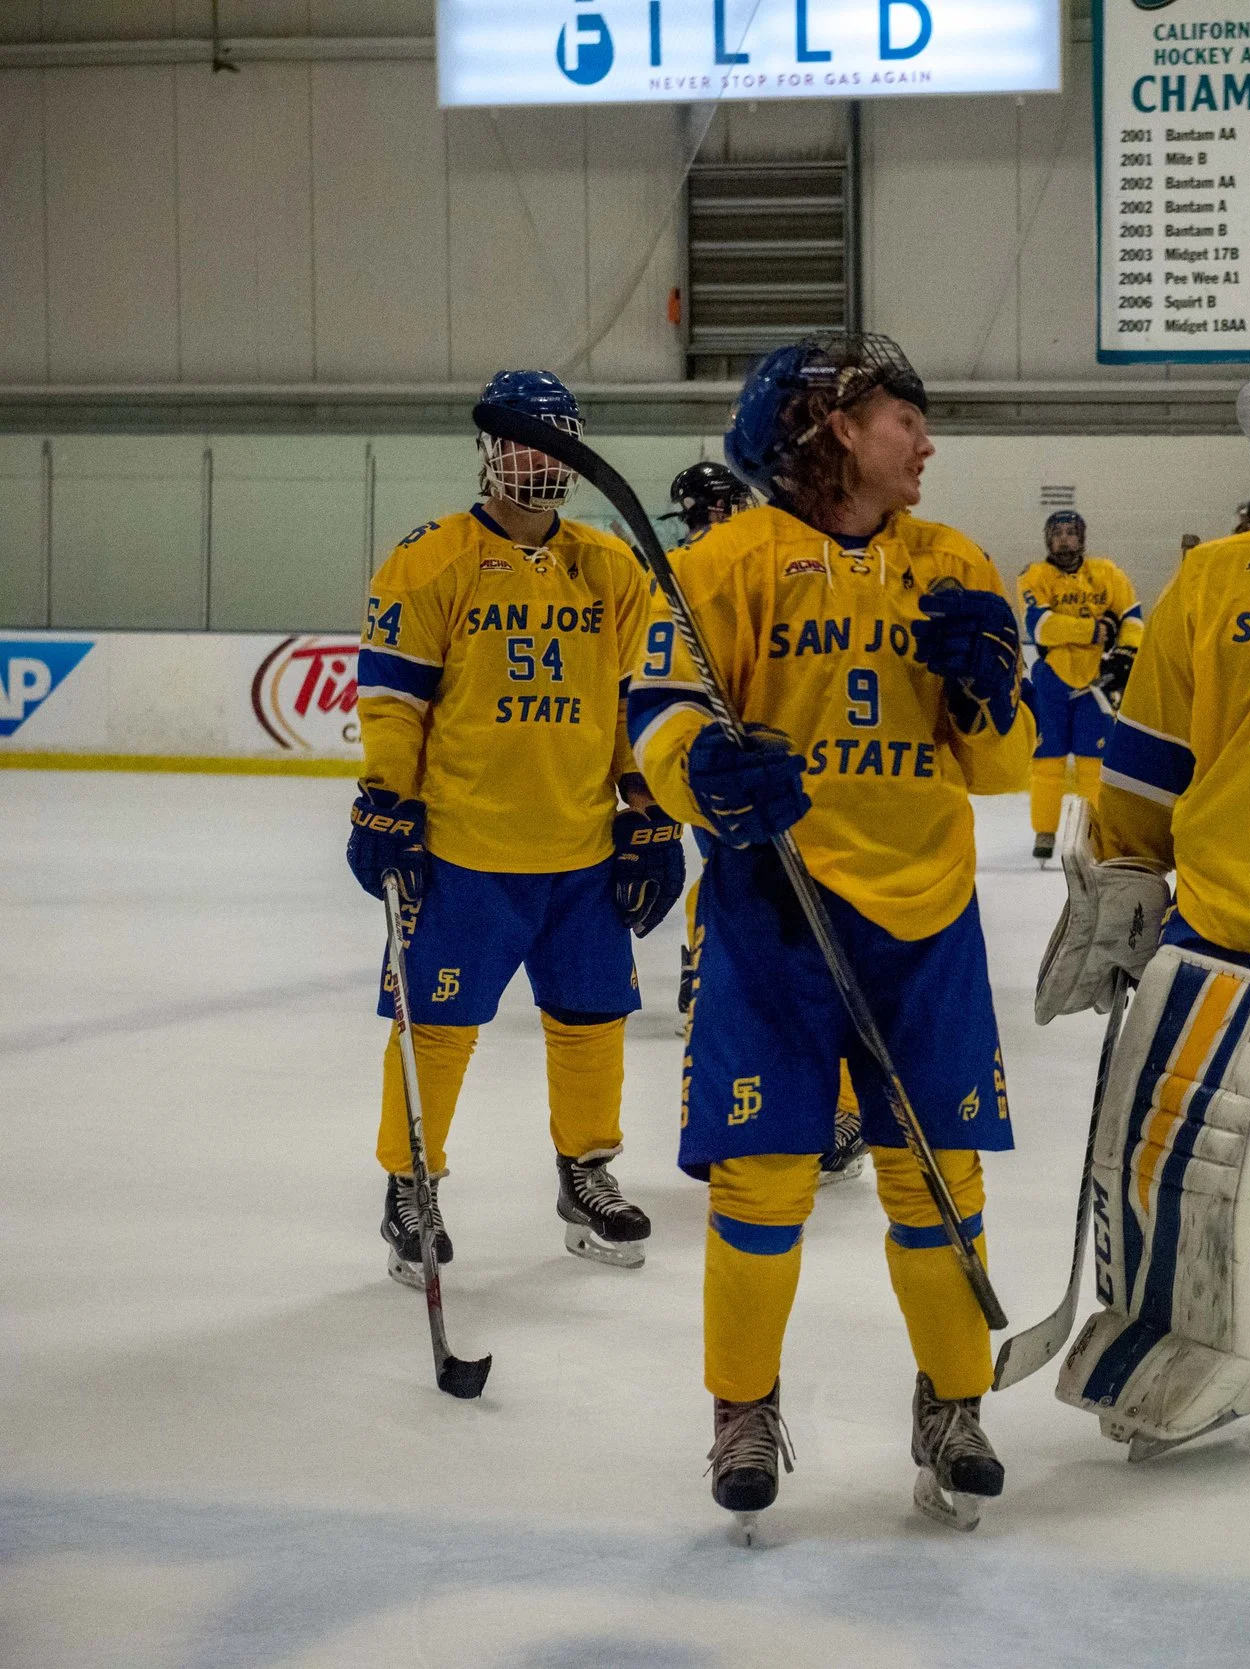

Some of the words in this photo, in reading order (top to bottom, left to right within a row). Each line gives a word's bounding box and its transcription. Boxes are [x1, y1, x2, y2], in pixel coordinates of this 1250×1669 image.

[1154, 47, 1233, 65] HOCKEY
[649, 76, 711, 90] NEVER
[721, 75, 767, 89] STOP
[777, 73, 814, 87] FOR
[824, 72, 861, 86] GAS
[871, 71, 932, 84] AGAIN
[1120, 129, 1152, 143] 2001
[1165, 128, 1215, 142] Bantam
[1219, 127, 1236, 141] AA
[1120, 153, 1152, 167] 2001
[1165, 152, 1194, 166] Mite
[1197, 151, 1208, 166] B
[1120, 176, 1153, 191] 2002
[1165, 176, 1215, 190] Bantam
[1218, 175, 1236, 189] AA
[1119, 200, 1153, 215] 2002
[1164, 200, 1215, 214] Bantam
[1218, 199, 1227, 212] A
[1119, 224, 1153, 239] 2003
[1164, 224, 1214, 238] Bantam
[1217, 223, 1228, 237] B
[1119, 248, 1153, 262] 2003
[1164, 247, 1209, 264] Midget
[1214, 246, 1240, 261] 17B
[1118, 271, 1153, 286] 2004
[1164, 271, 1188, 285] Pee
[1192, 271, 1219, 285] Wee
[1223, 271, 1239, 285] A1
[1164, 295, 1203, 311] Squirt
[1207, 295, 1217, 309] B
[1117, 319, 1152, 333] 2007
[1164, 319, 1208, 335] Midget
[1213, 318, 1247, 333] 18AA
[366, 597, 403, 646] 54
[467, 604, 529, 635] SAN
[541, 600, 604, 633] JOSÉ
[768, 617, 851, 659] SAN
[865, 619, 920, 661] JO
[506, 636, 564, 683] 54
[643, 620, 675, 679] 9
[846, 667, 881, 729] 9
[495, 695, 581, 724] STATE
[808, 739, 935, 777] STATE
[350, 805, 415, 836] AUER
[631, 823, 684, 845] BAU
[1092, 1176, 1114, 1307] CCM
